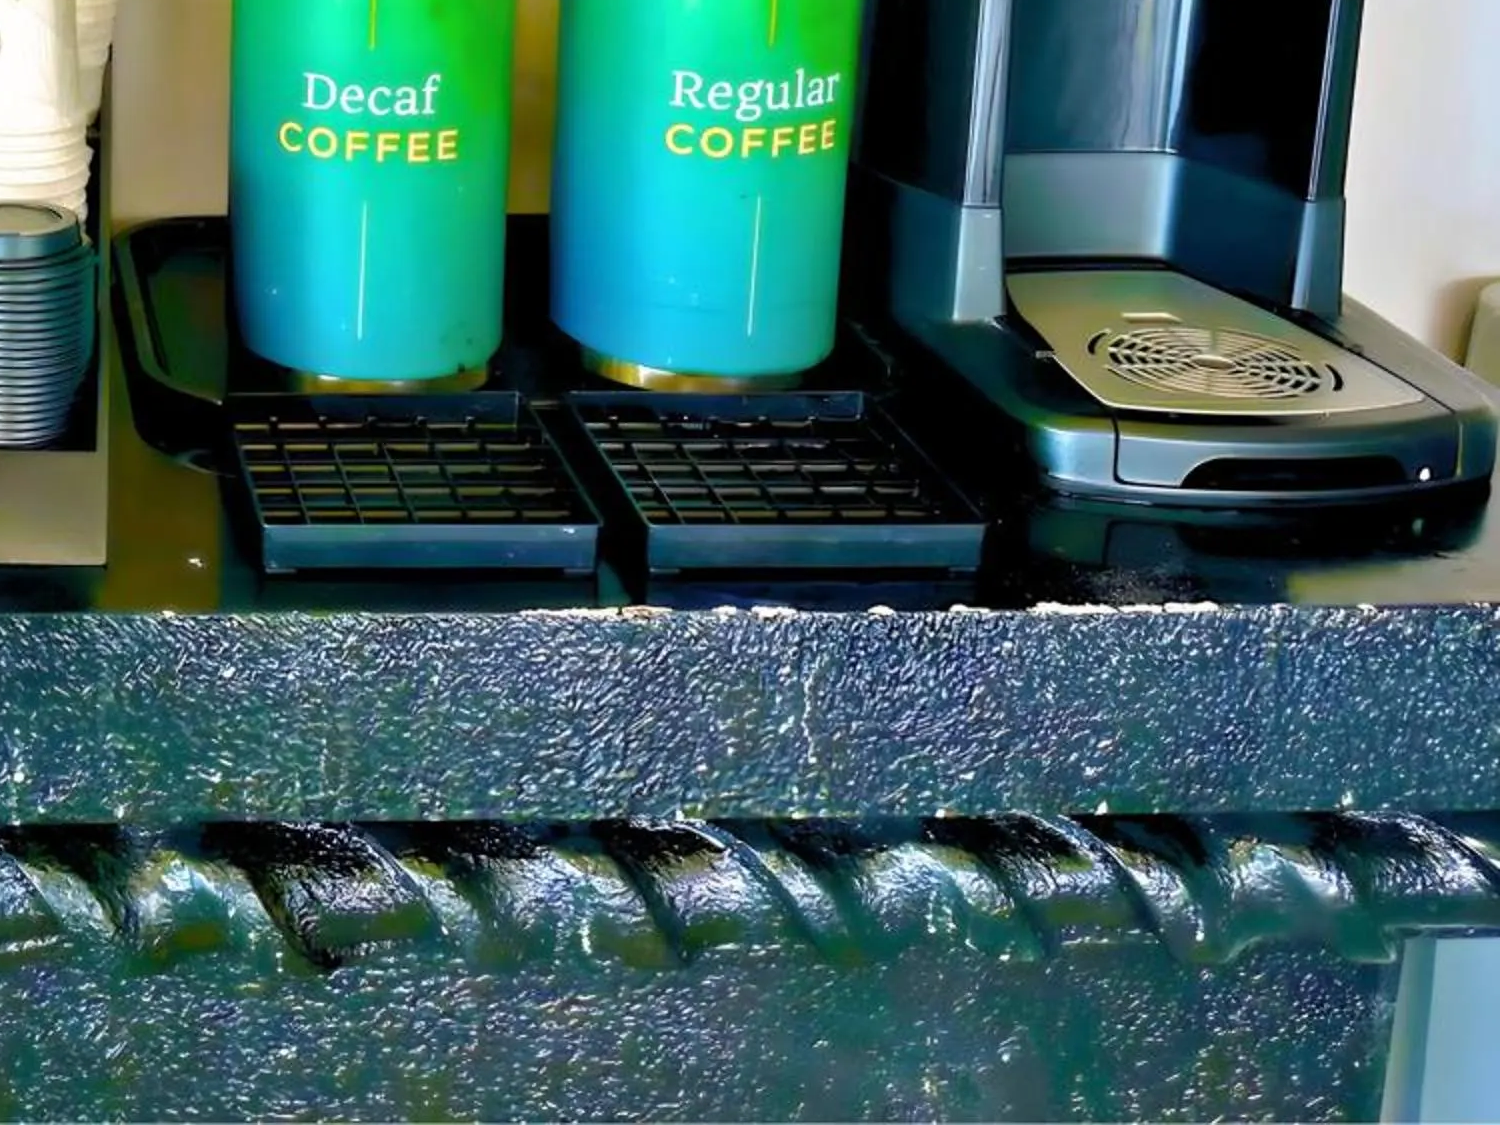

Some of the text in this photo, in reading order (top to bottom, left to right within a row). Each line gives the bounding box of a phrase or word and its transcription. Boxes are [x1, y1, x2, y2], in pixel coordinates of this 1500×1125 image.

[302, 72, 441, 116] Decaf
[669, 67, 841, 122] Regular
[279, 121, 459, 163] COFFEE
[665, 118, 837, 159] COFFEE
